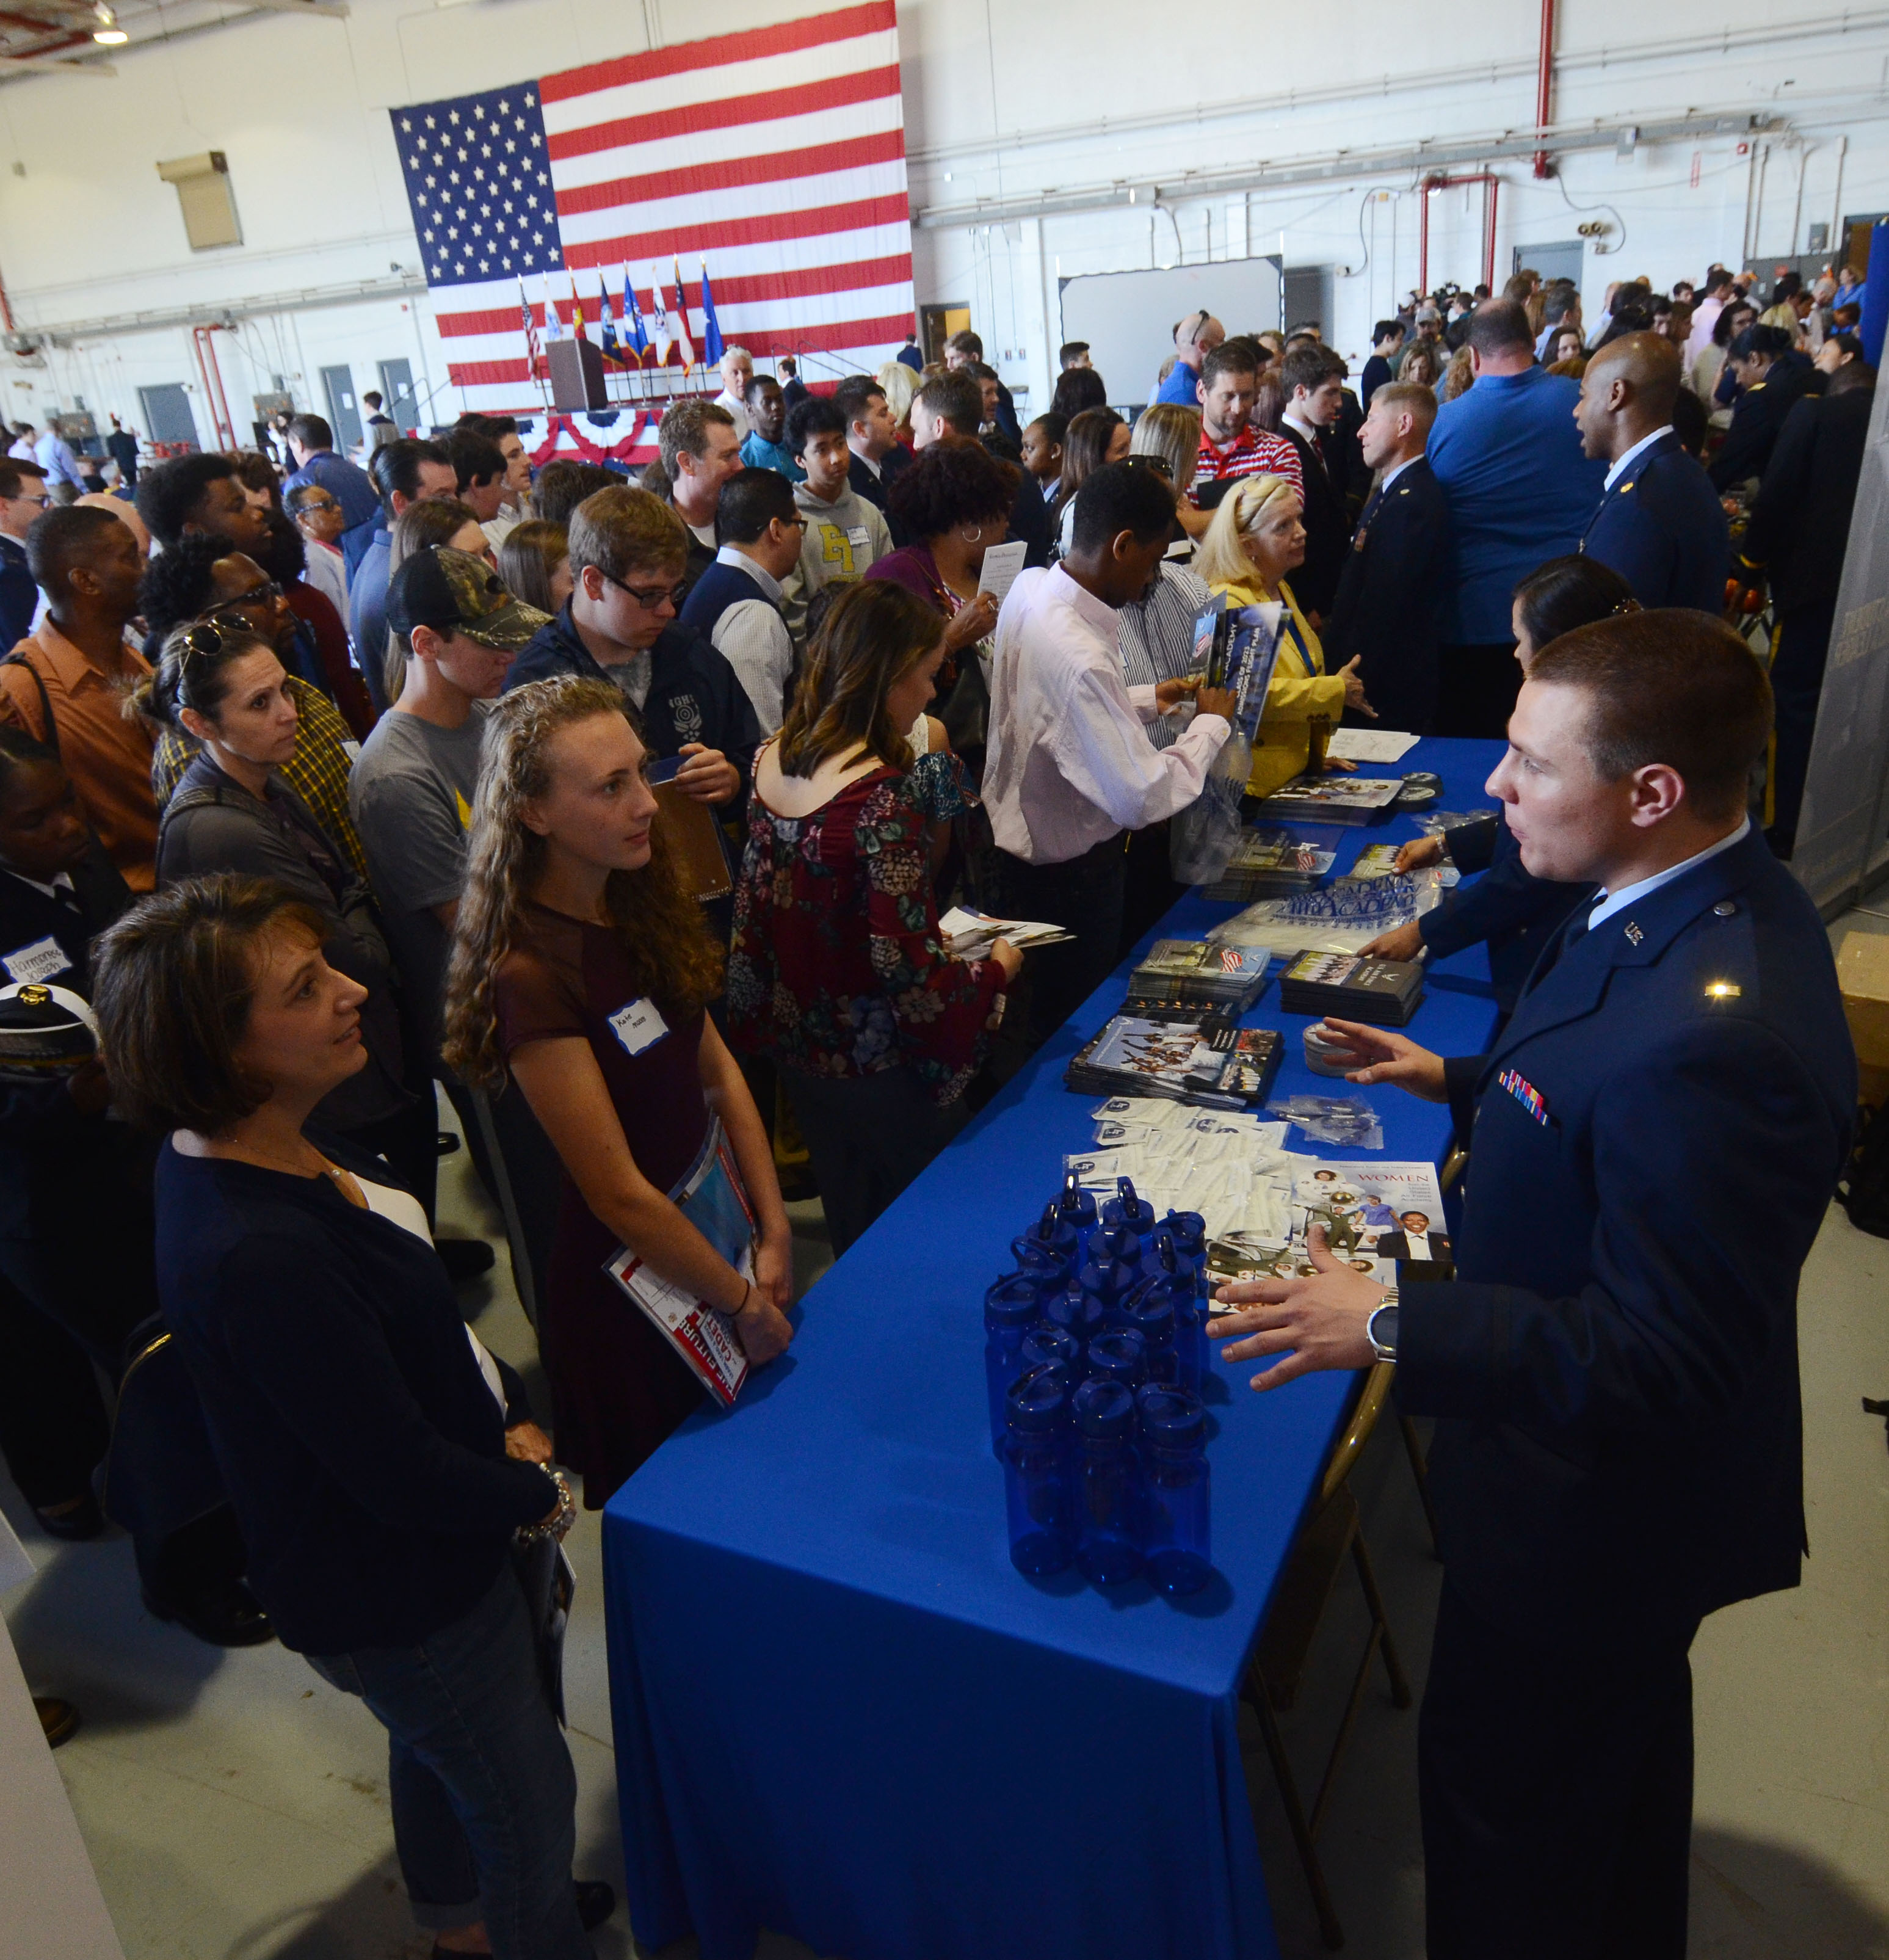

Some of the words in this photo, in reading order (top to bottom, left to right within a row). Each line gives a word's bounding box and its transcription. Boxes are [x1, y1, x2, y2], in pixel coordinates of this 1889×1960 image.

[1358, 1174, 1429, 1182] WOMEN
[678, 1319, 716, 1370] FUTURE
[706, 1318, 732, 1362] CADET
